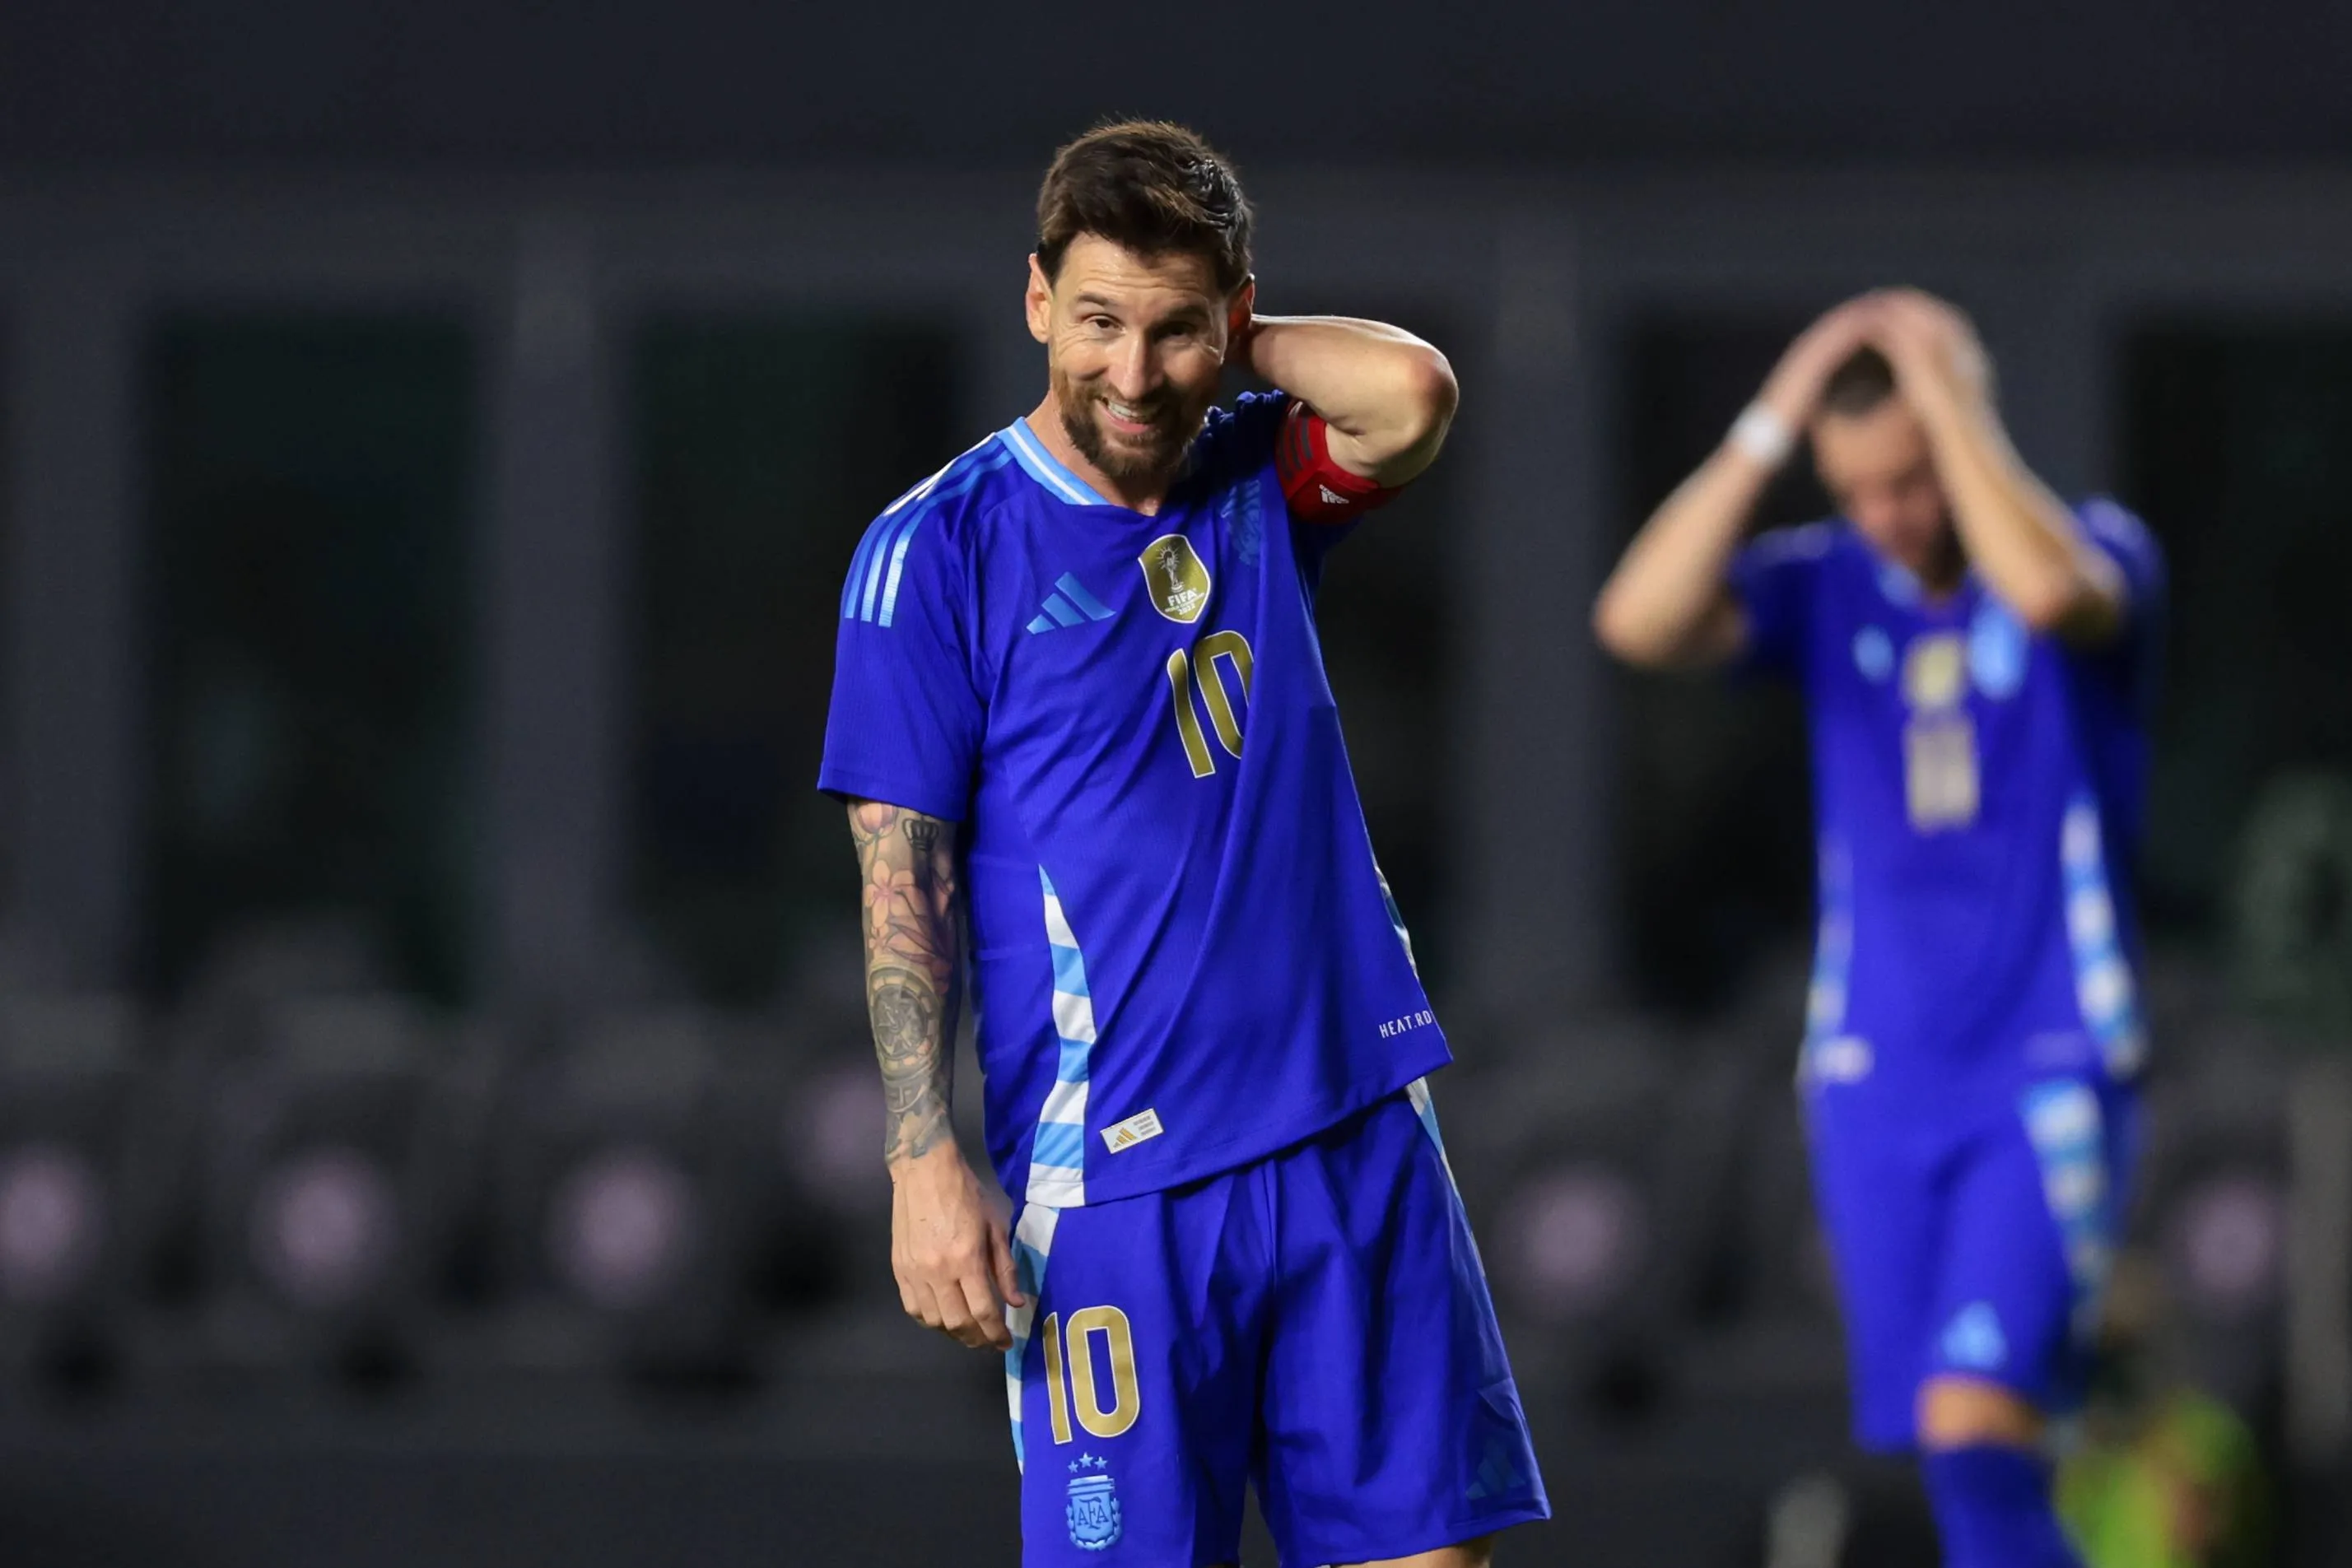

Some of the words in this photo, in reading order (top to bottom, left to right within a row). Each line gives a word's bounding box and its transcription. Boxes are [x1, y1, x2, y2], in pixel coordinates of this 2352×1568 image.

[1167, 589, 1197, 606] FIFA
[1167, 630, 1255, 778] 10
[1042, 1305, 1140, 1445] 10
[1077, 1496, 1109, 1529] AFA
